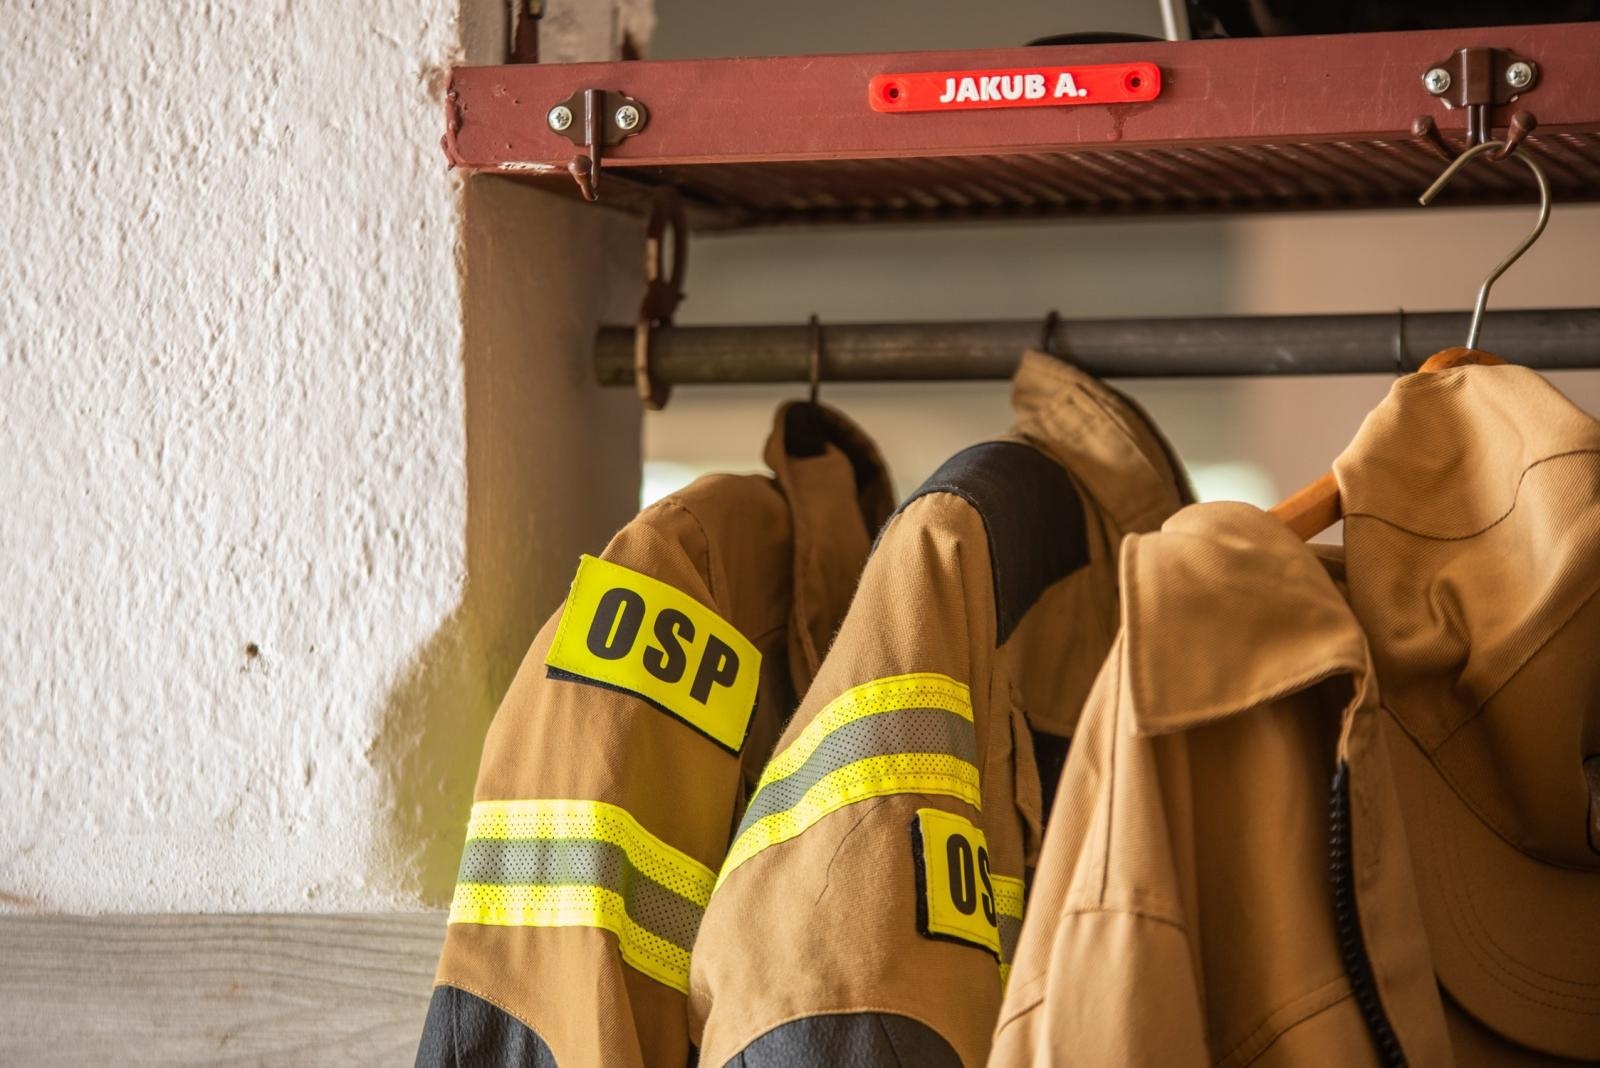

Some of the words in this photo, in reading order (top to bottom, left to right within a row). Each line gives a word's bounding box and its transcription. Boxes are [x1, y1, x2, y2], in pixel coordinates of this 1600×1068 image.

[939, 74, 1046, 103] JAKUB
[1053, 72, 1088, 98] A.
[586, 587, 740, 706] OSP
